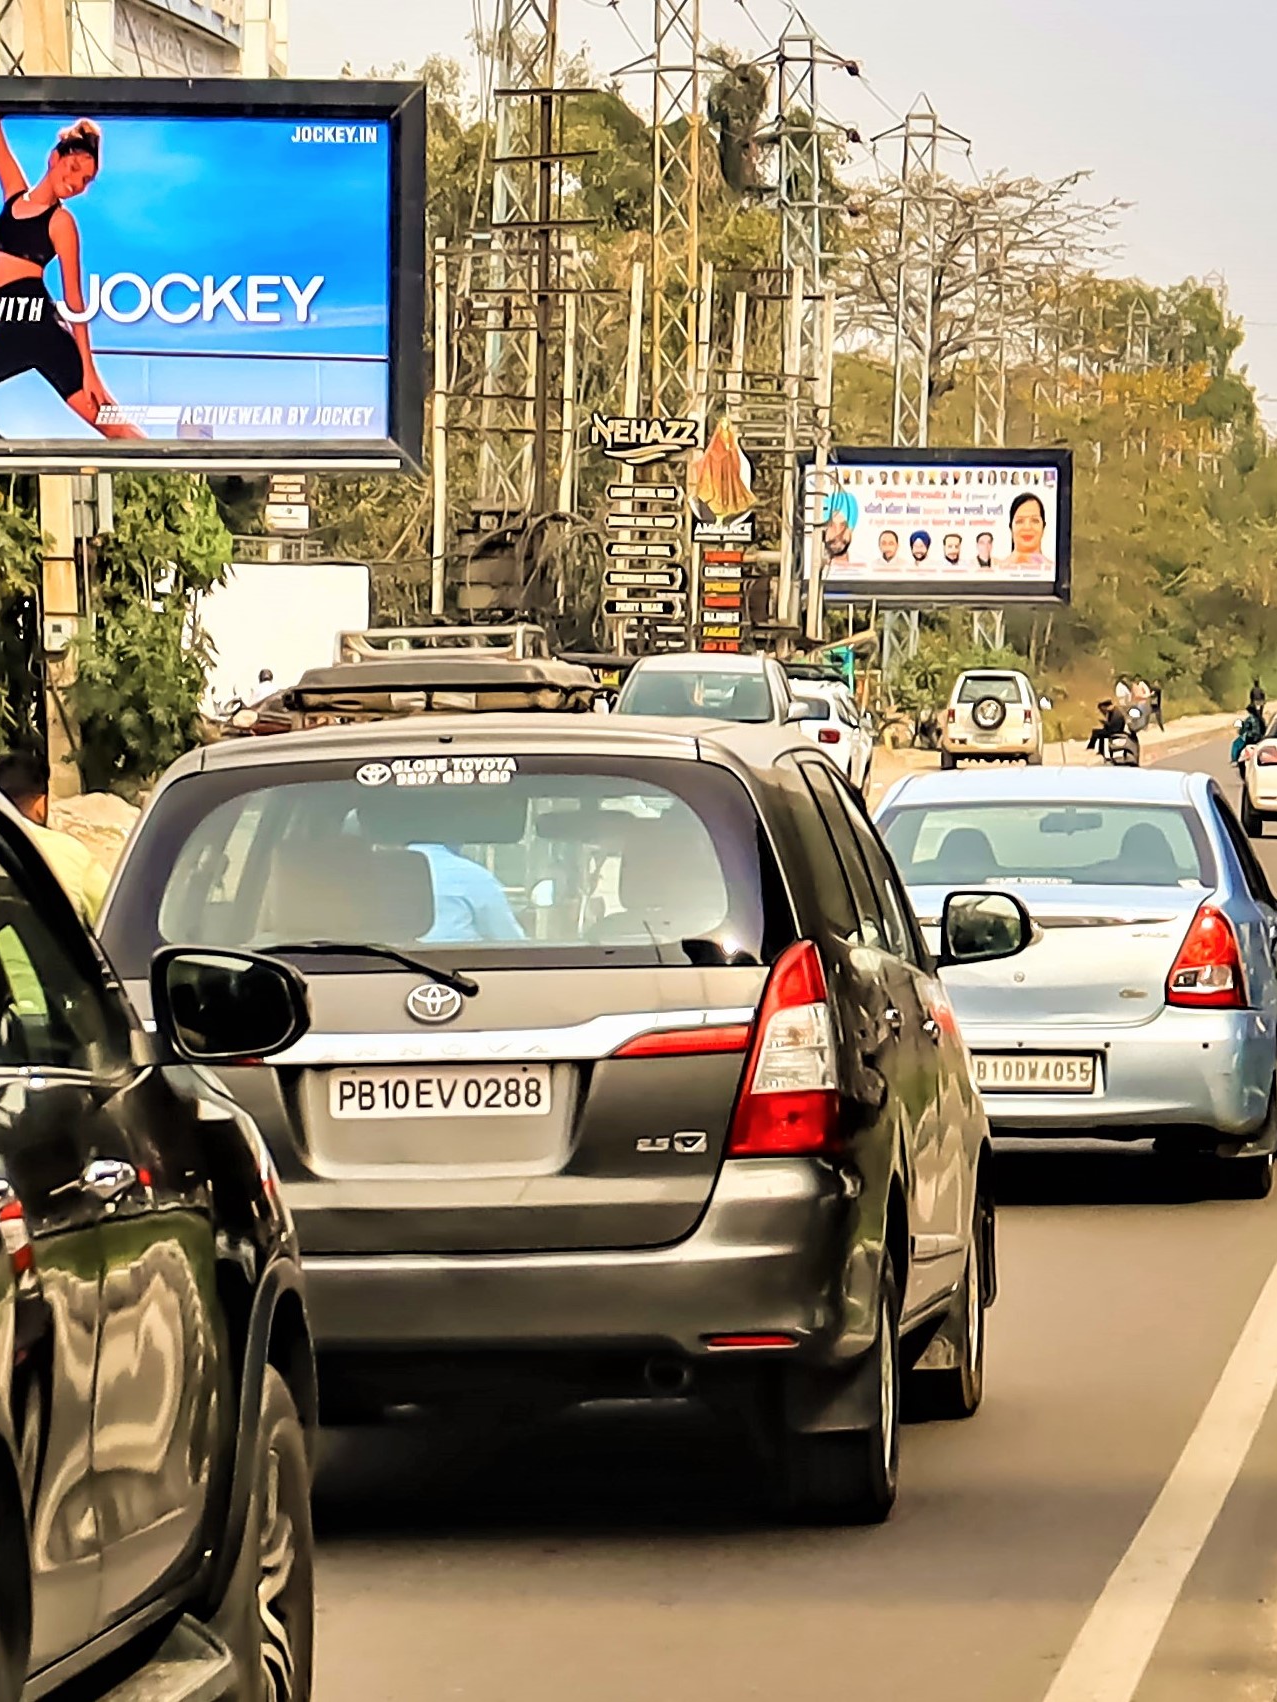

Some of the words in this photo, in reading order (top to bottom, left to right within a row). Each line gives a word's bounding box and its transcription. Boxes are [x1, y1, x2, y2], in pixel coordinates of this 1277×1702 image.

[291, 126, 377, 143] JOCKEY.IN
[56, 272, 324, 323] JOCKEY
[181, 406, 281, 426] ACTIVEWEAR
[286, 406, 308, 426] BY
[311, 406, 375, 426] JOCKEY
[451, 757, 517, 771] TOYOTA
[977, 1060, 1093, 1082] B10DW4055
[338, 1077, 542, 1111] PB10EV0288
